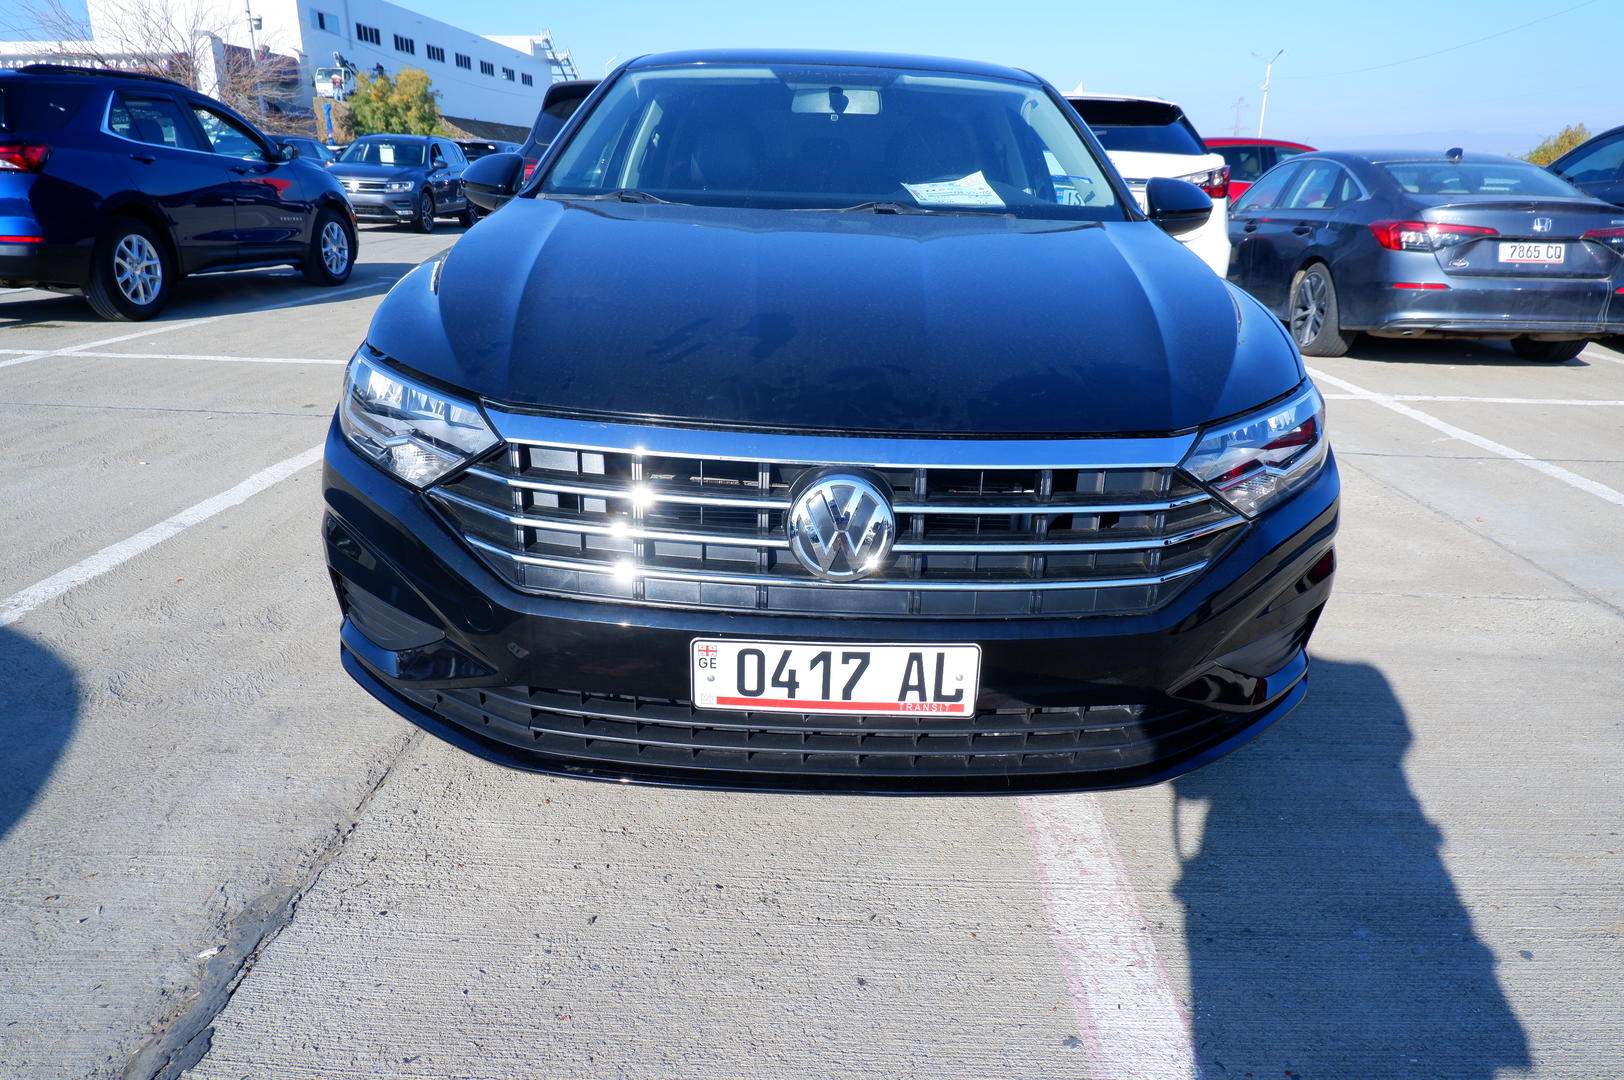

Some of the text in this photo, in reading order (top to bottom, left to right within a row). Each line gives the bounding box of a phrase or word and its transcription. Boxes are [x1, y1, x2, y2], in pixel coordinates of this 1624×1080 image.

[1510, 245, 1562, 259] 7865 CQ
[698, 657, 717, 669] GE
[736, 648, 964, 702] 0417 AL
[899, 702, 950, 712] TRANSIT
